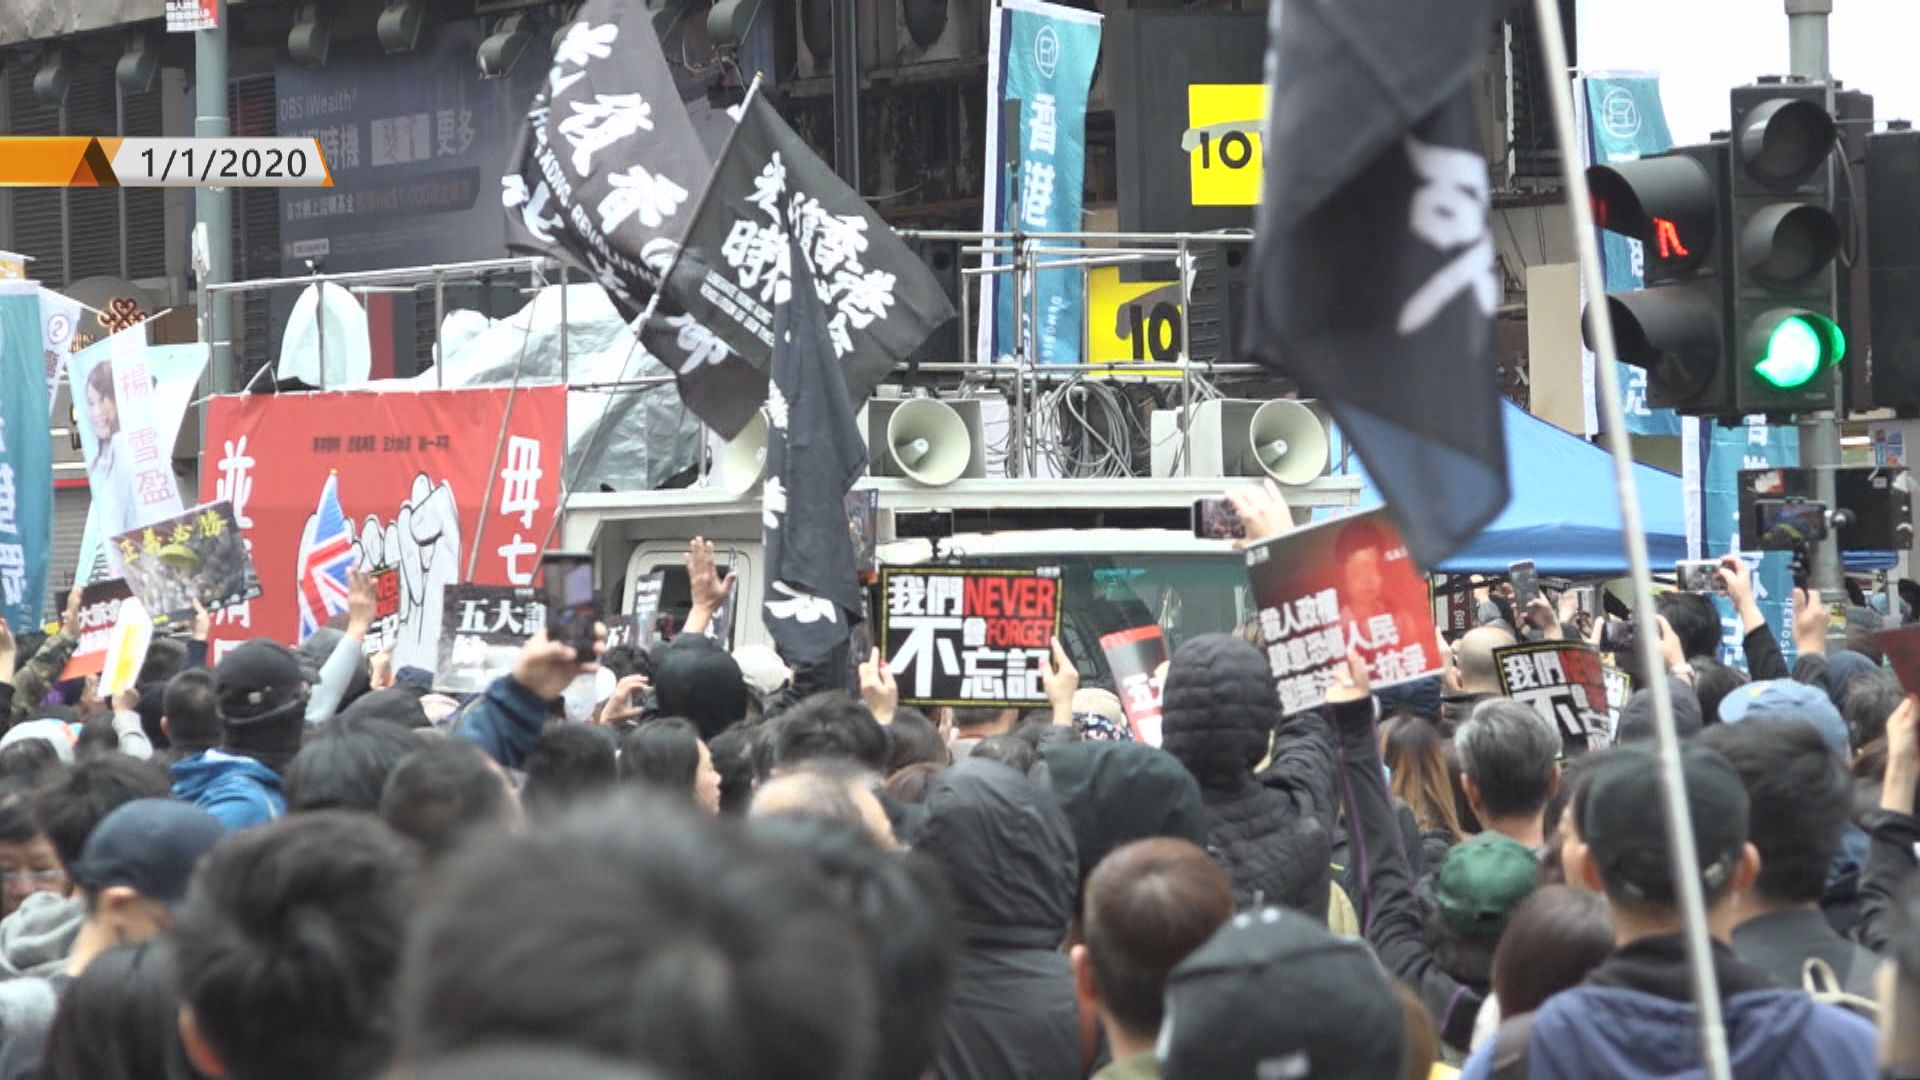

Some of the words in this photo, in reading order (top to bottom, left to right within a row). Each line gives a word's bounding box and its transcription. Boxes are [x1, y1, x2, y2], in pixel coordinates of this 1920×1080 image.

[436, 108, 475, 158] 更多
[1200, 130, 1265, 169] 10
[1130, 302, 1183, 363] 10
[888, 575, 964, 617] 我們
[964, 577, 1057, 617] NEVER
[986, 619, 1054, 648] FORGET
[887, 616, 963, 698] 不
[960, 647, 1051, 700] 忘記
